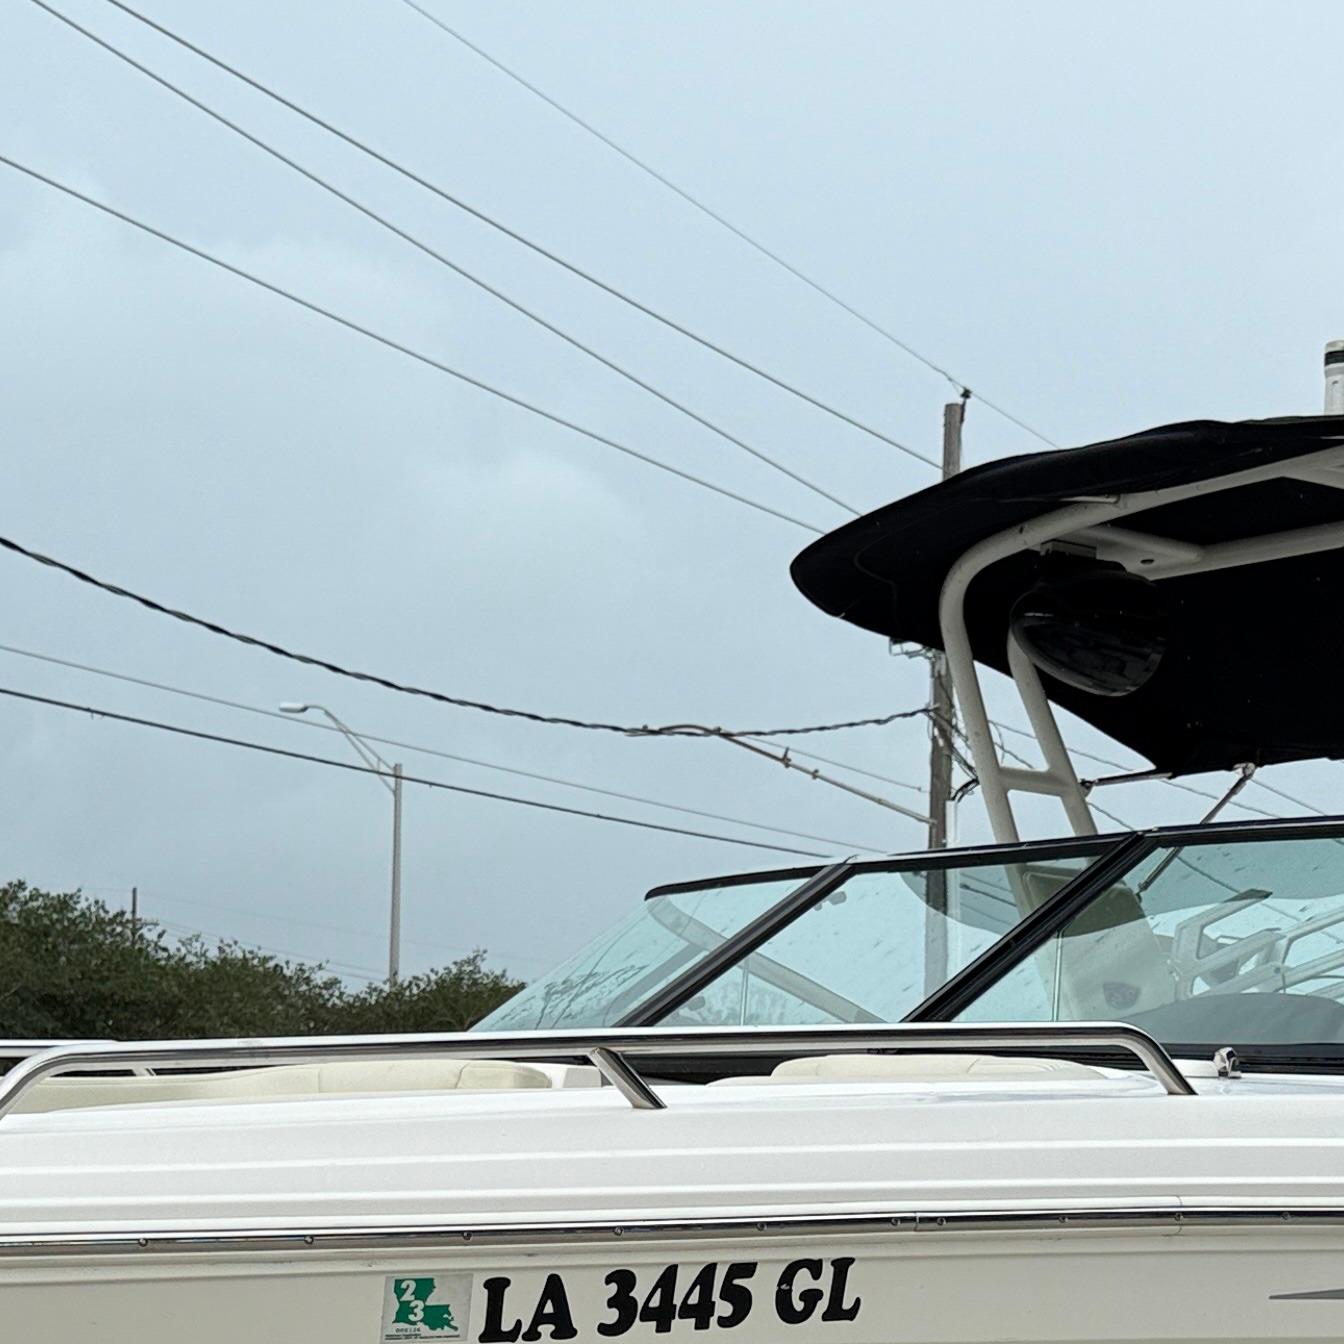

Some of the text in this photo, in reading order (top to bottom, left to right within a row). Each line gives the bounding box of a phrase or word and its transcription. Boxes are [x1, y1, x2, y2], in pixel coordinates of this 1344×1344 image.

[478, 1257, 861, 1343] LA 3445 GL
